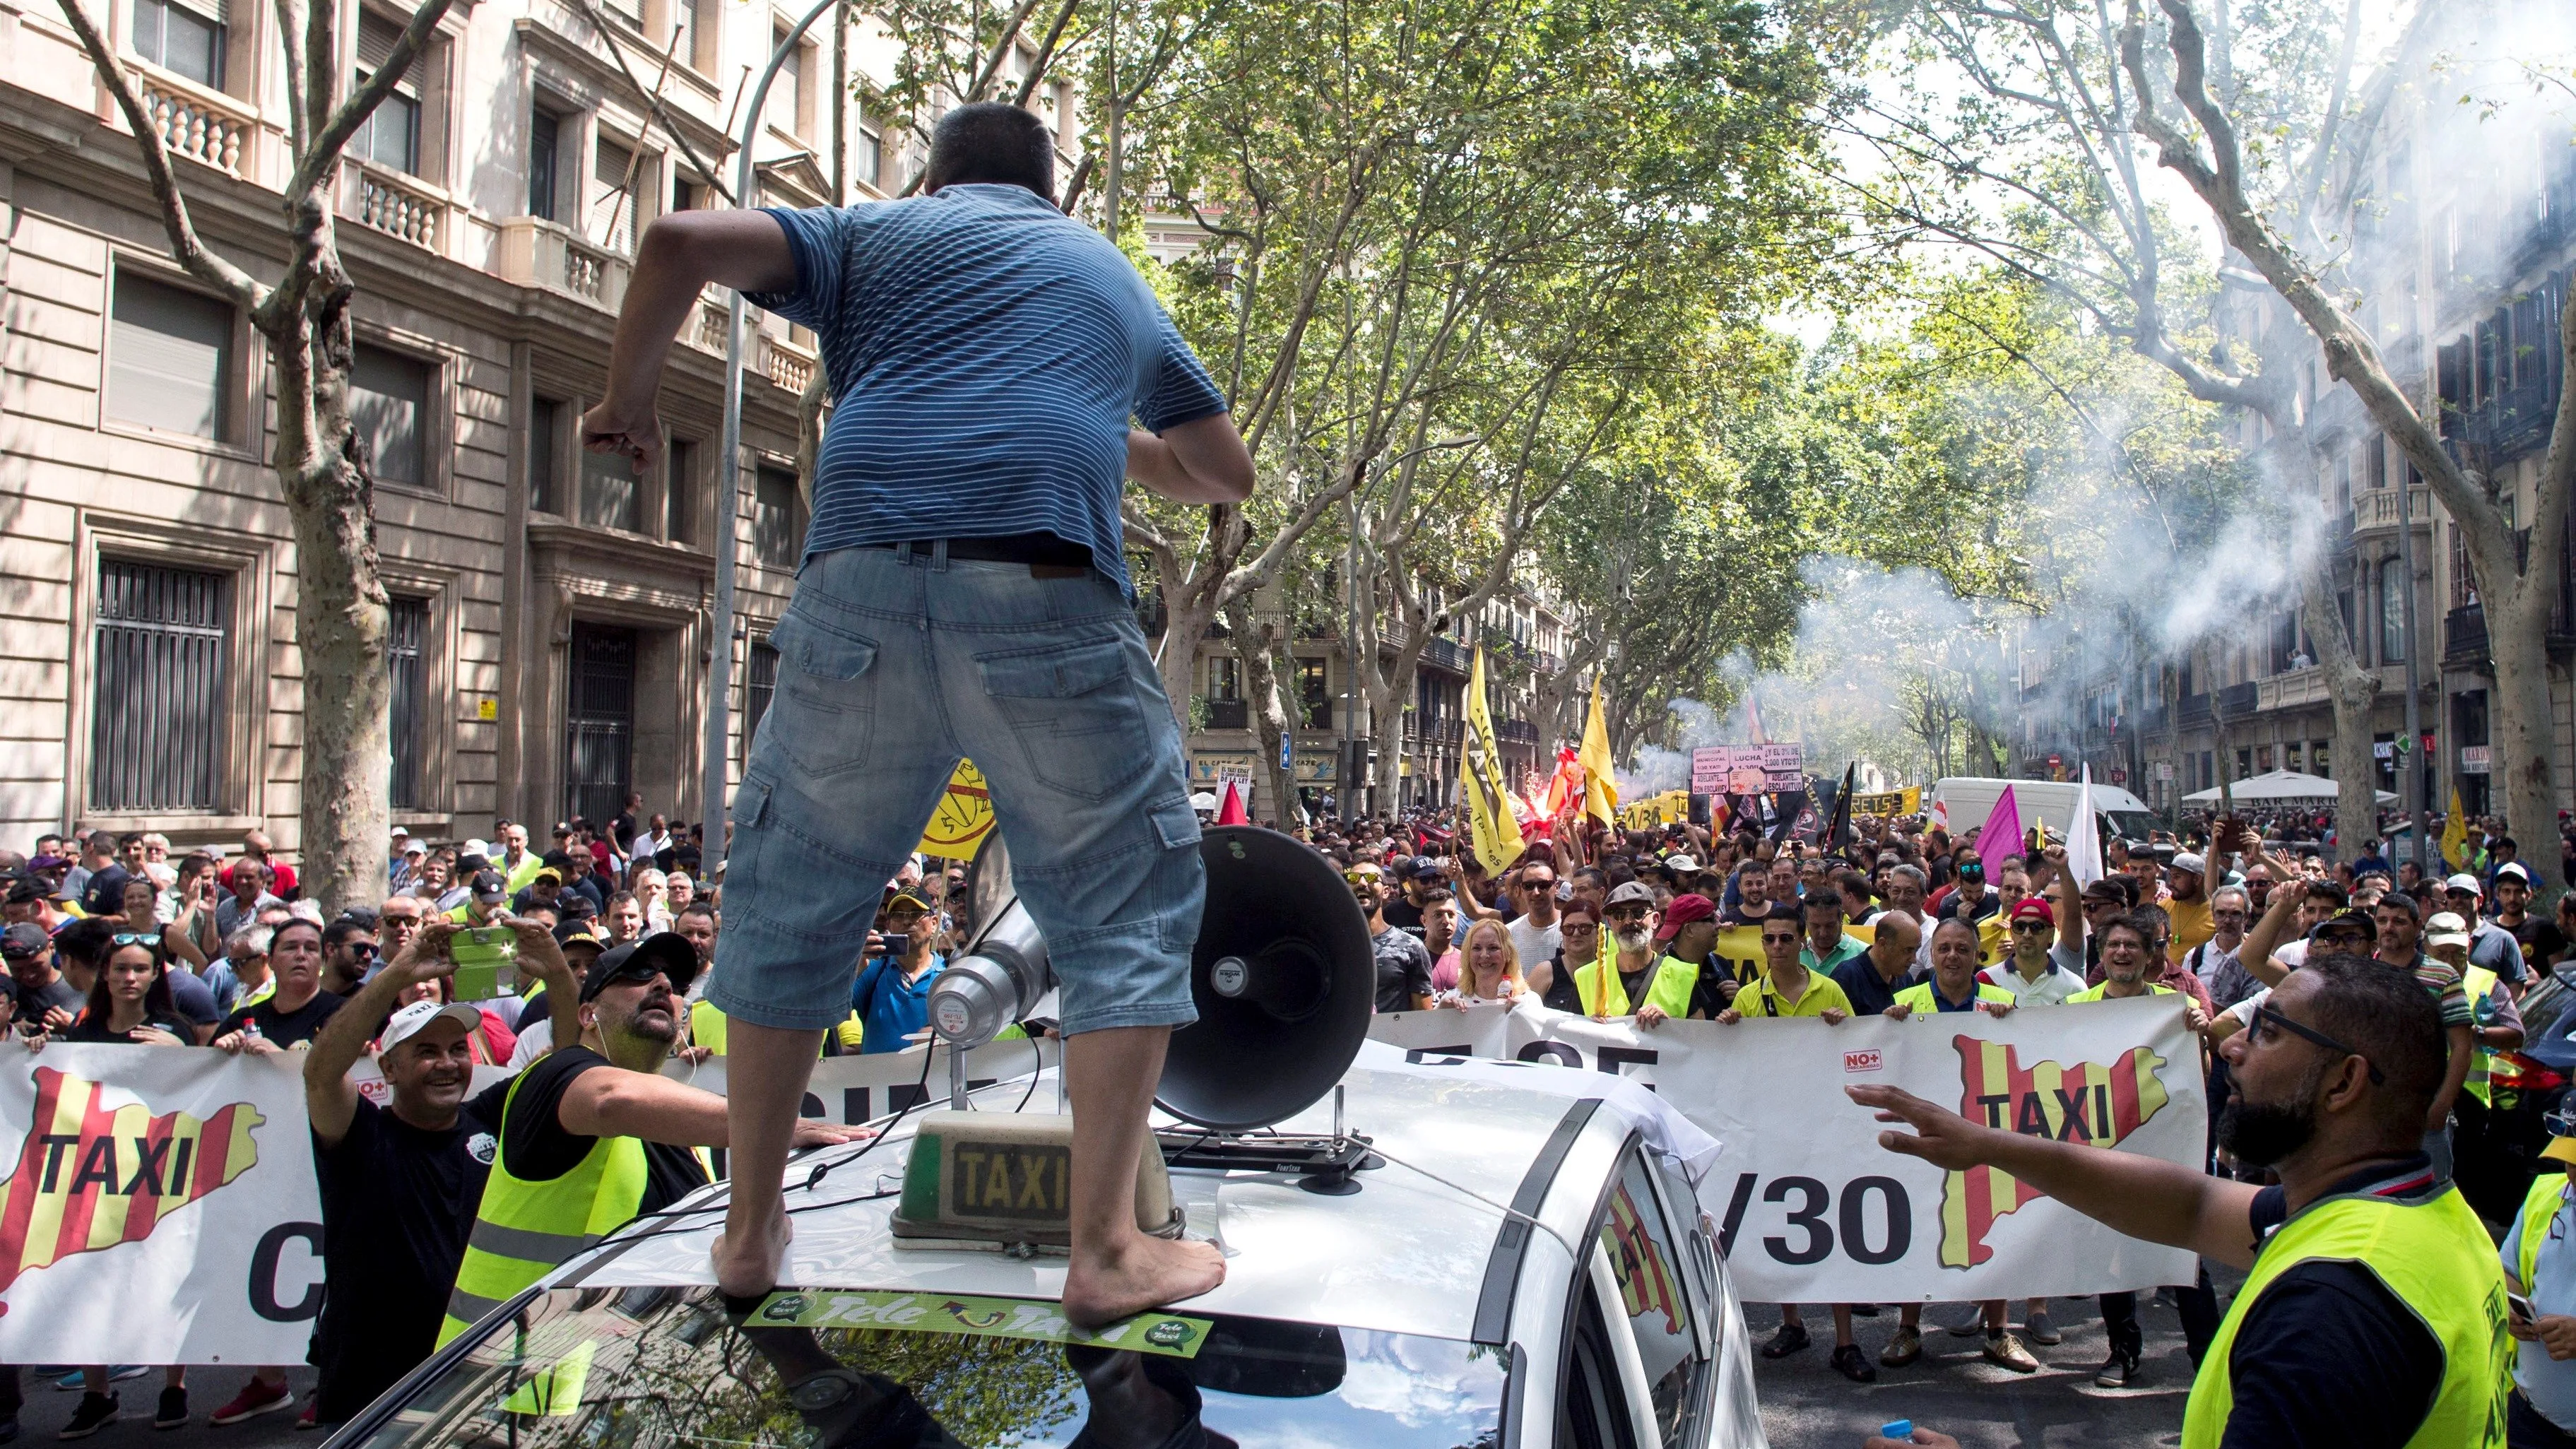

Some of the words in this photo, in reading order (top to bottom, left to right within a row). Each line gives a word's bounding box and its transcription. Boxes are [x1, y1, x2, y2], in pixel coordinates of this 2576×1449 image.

[1768, 783, 1802, 791] ESCLAVITUD
[1850, 796, 1891, 812] RETS
[2252, 797, 2283, 806] BAR
[1977, 1084, 2112, 1142] TAXI
[40, 1135, 194, 1197] TAXI
[959, 1152, 1066, 1210] TAXI
[1718, 1173, 1913, 1266] /30
[814, 1296, 928, 1325] Tele
